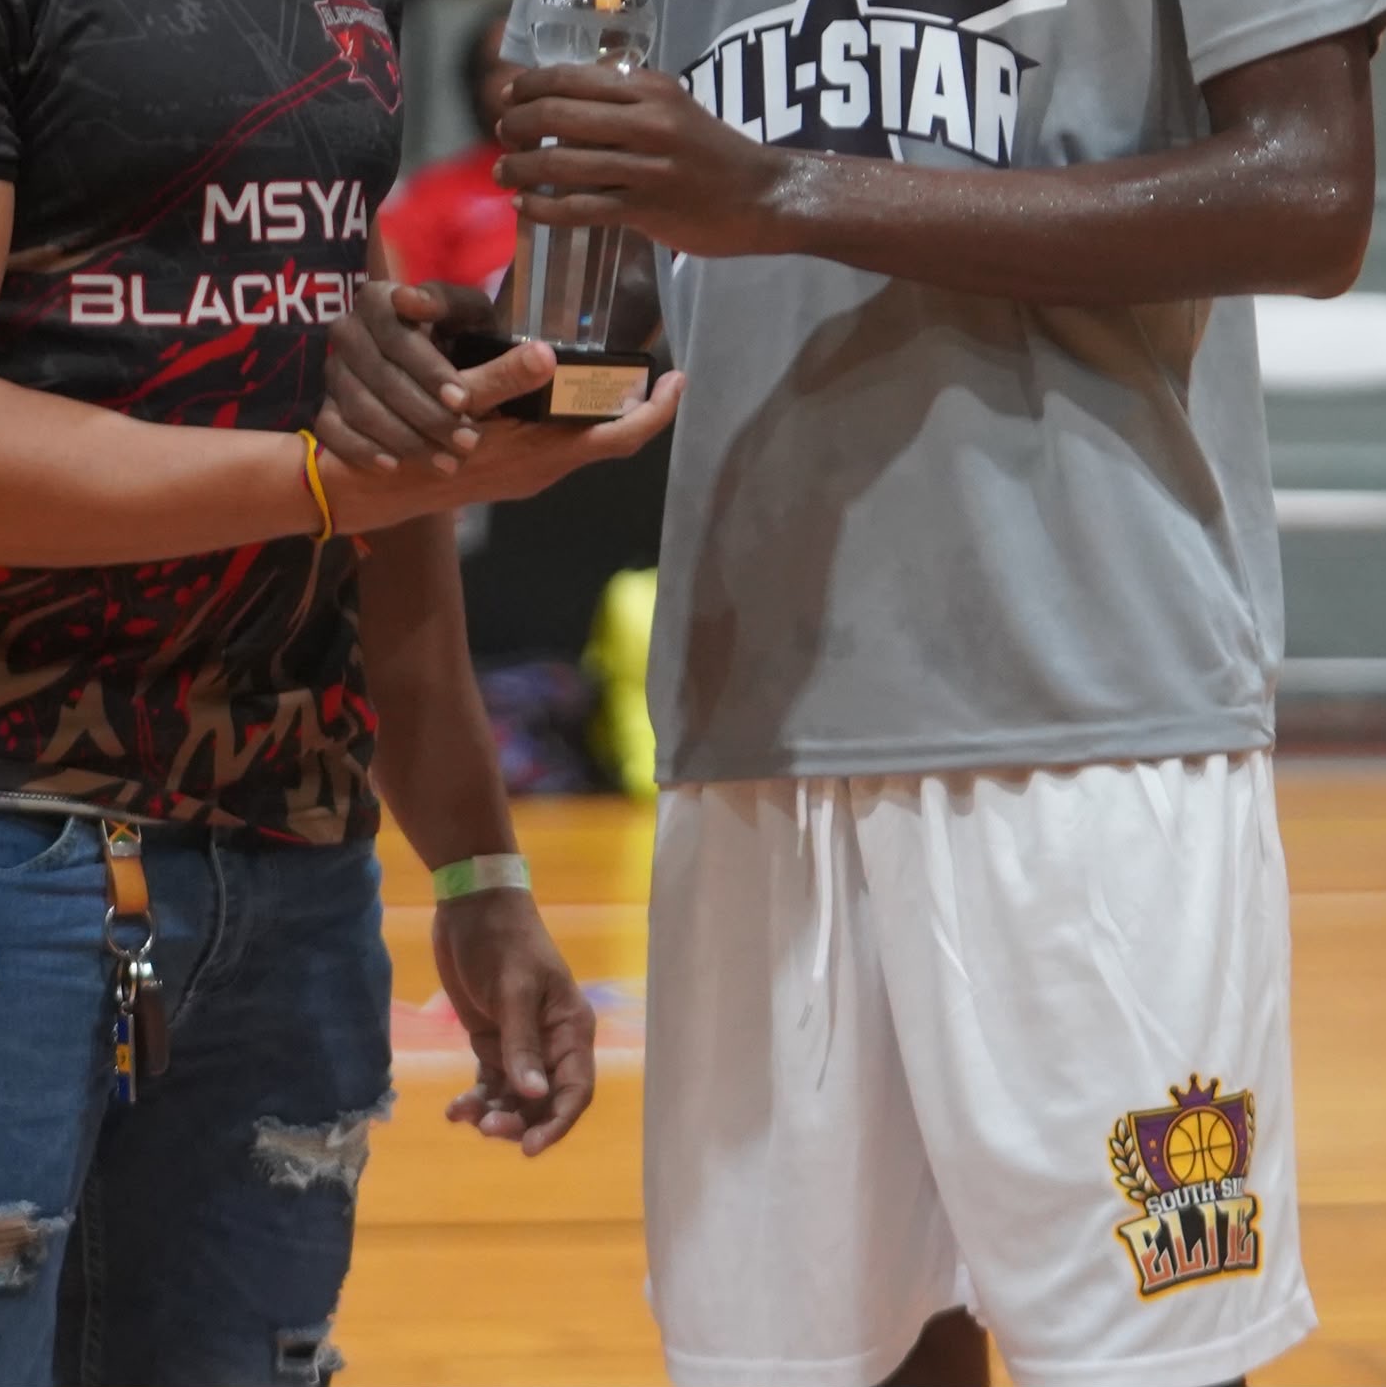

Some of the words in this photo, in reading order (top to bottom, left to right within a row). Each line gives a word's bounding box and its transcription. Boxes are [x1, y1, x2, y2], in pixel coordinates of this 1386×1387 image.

[201, 180, 368, 243] MSYA
[69, 272, 369, 325] BLACKBI
[1145, 1180, 1216, 1215] SOUTH
[1119, 1196, 1256, 1294] ELITE
